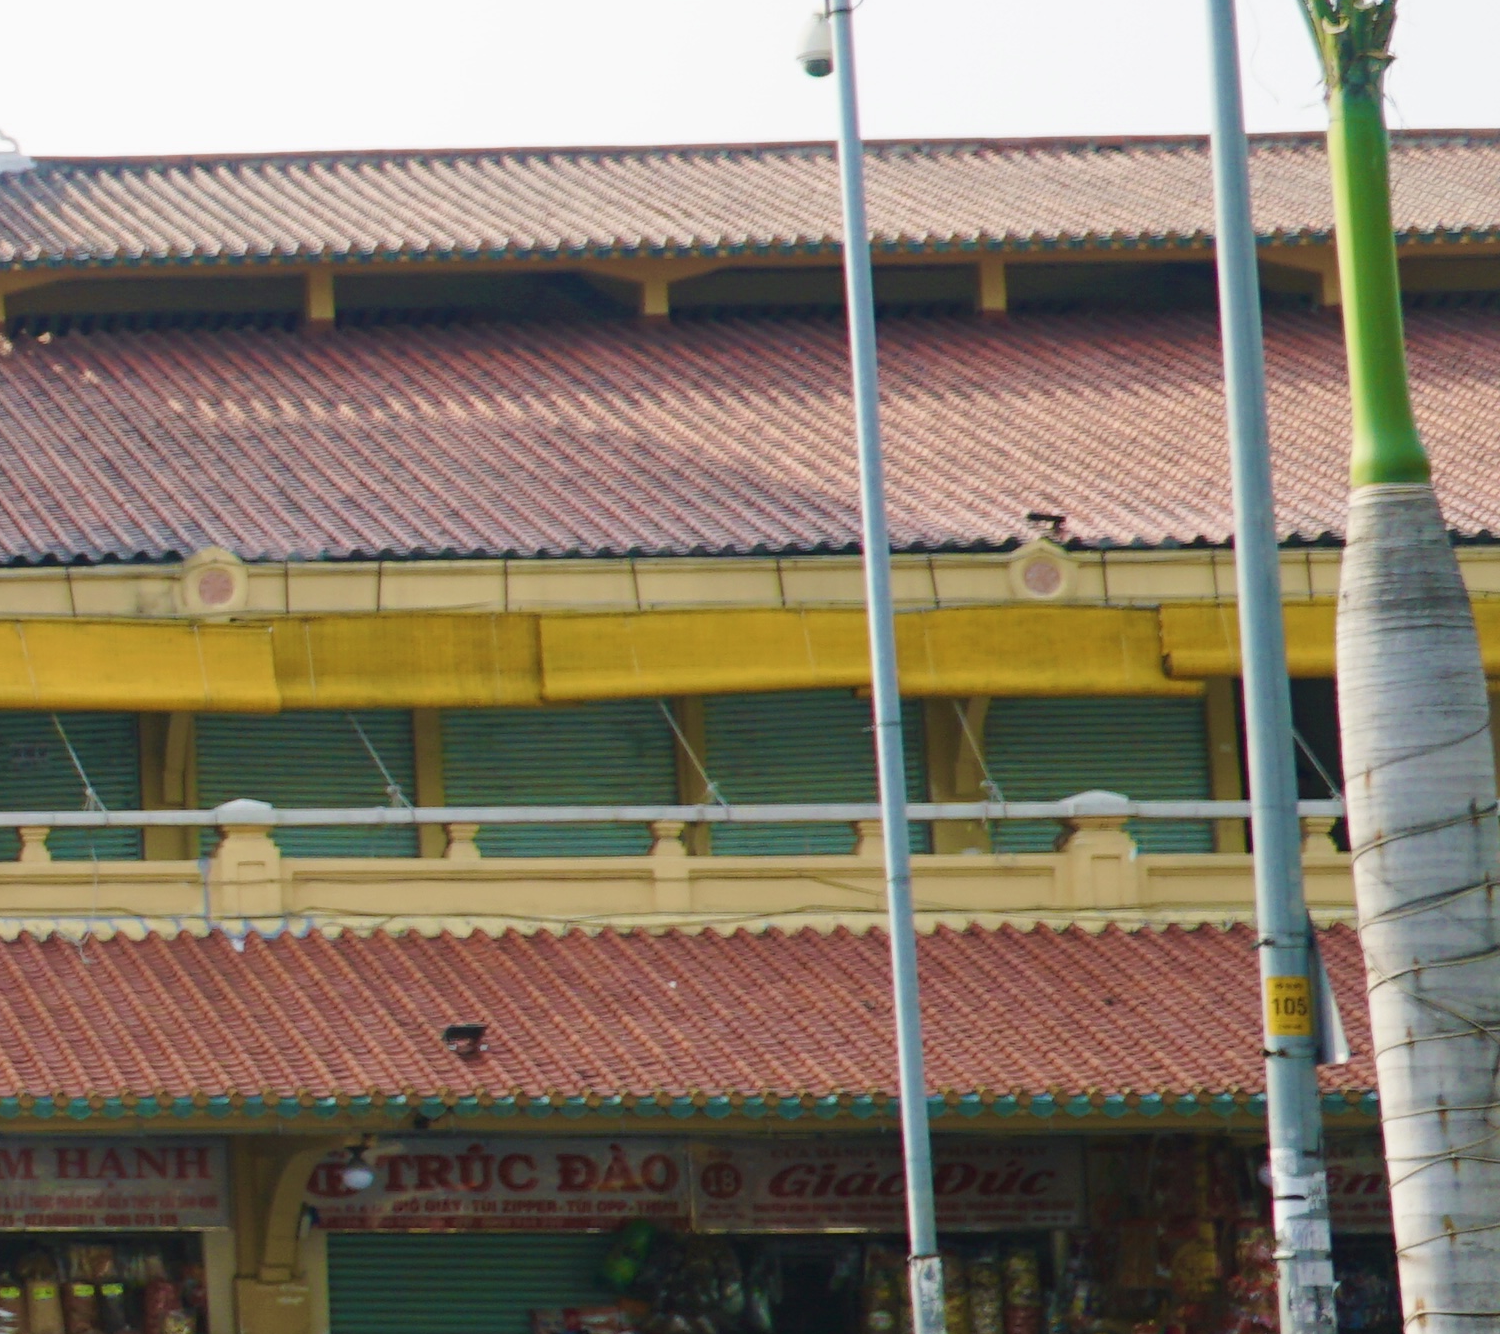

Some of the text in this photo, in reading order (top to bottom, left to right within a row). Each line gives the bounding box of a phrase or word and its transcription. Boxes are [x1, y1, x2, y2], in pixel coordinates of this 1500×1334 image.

[1272, 997, 1308, 1016] 105
[53, 1146, 213, 1188] HẠNH
[376, 1143, 540, 1193] TRÚC
[556, 1142, 680, 1193] ĐÀO
[708, 1168, 736, 1192] 18
[768, 1160, 906, 1198] Giác
